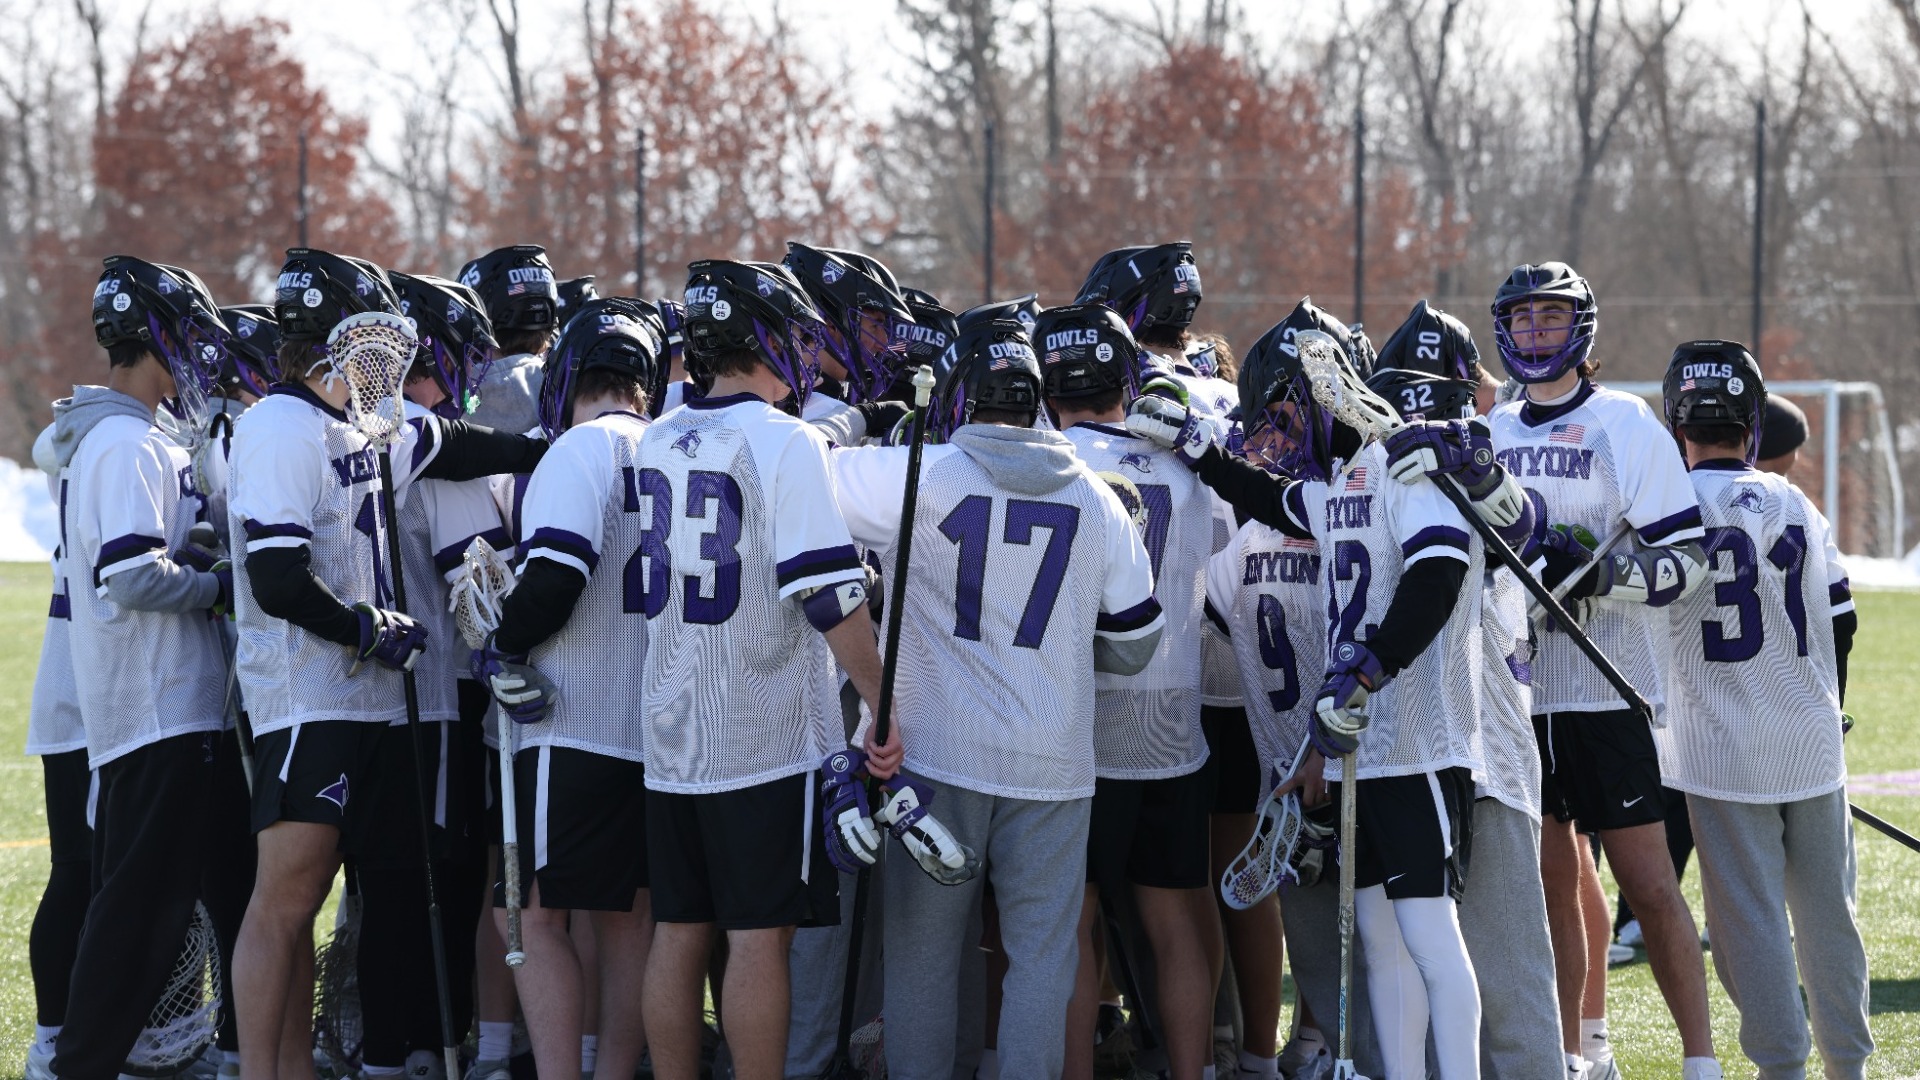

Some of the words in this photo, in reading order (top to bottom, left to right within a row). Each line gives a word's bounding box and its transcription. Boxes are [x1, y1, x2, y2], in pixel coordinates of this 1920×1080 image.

[276, 272, 312, 289] WLS
[508, 267, 553, 284] OWLS
[1128, 260, 1142, 279] 1
[684, 286, 718, 306] WLS
[896, 323, 946, 348] OWLS
[1046, 328, 1098, 351] OWLS
[1417, 331, 1441, 360] 20
[941, 342, 959, 373] 17
[1683, 363, 1733, 380] OWLS
[1401, 384, 1434, 411] 32
[639, 467, 743, 625] 33
[937, 494, 1081, 650] 17
[1700, 524, 1809, 663] 31
[1257, 594, 1300, 713] 9
